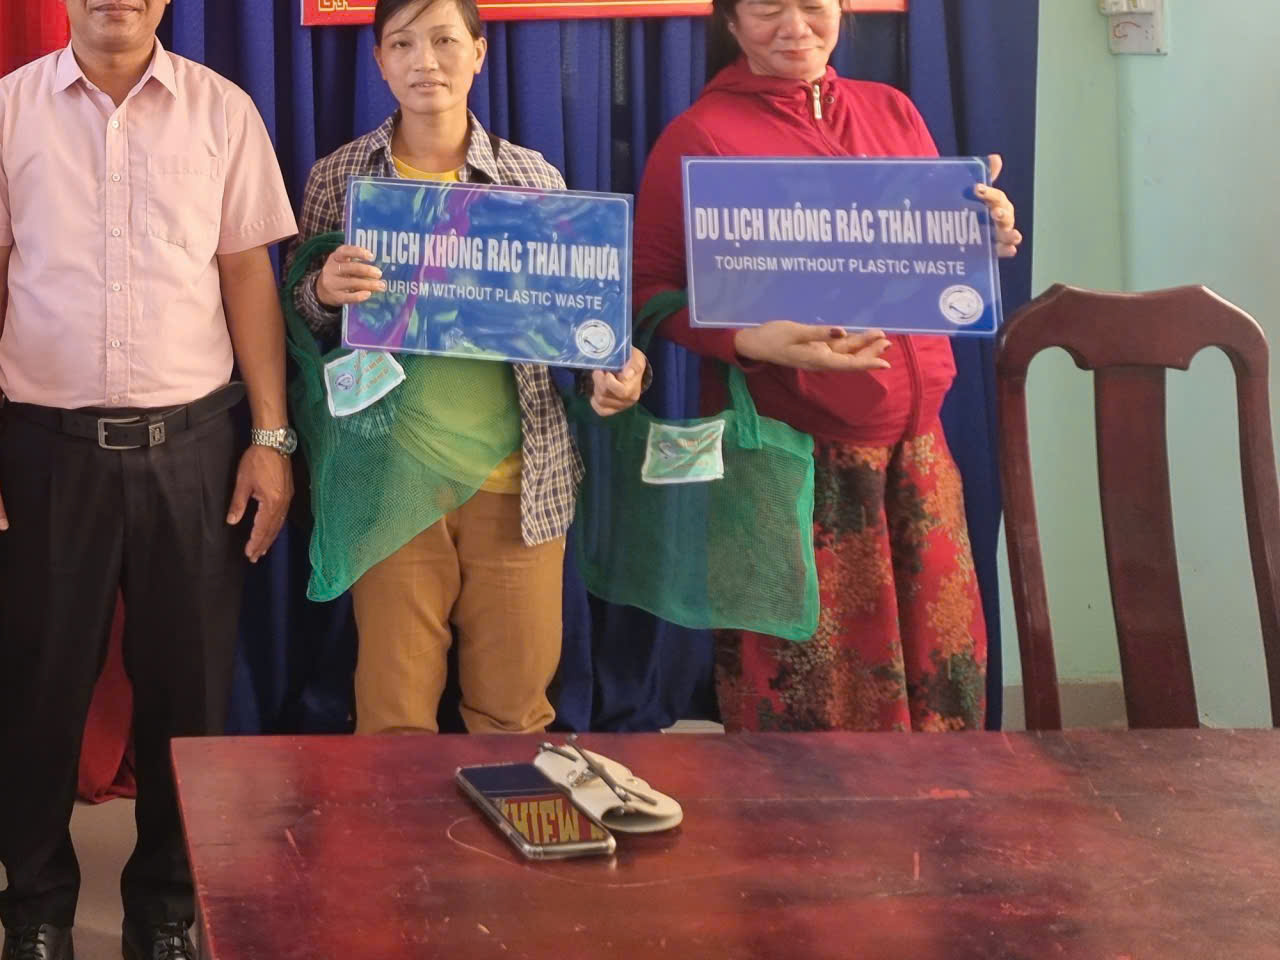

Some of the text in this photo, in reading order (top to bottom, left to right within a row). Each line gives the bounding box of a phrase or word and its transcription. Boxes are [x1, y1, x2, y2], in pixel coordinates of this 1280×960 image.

[695, 198, 982, 252] DU LỊCH KHÔNG RÁC THẢI NHỰA
[382, 231, 420, 271] LỊCH
[424, 231, 483, 269] KHÔNG
[487, 233, 522, 273] RÁC
[528, 232, 566, 276] THẢI
[570, 243, 620, 287] NHỰA
[715, 256, 965, 275] TOURISM WITHOUT PLASTIC WASTE
[432, 283, 493, 301] WITHOUT
[495, 289, 552, 305] PLASTIC
[555, 293, 602, 310] WASTE
